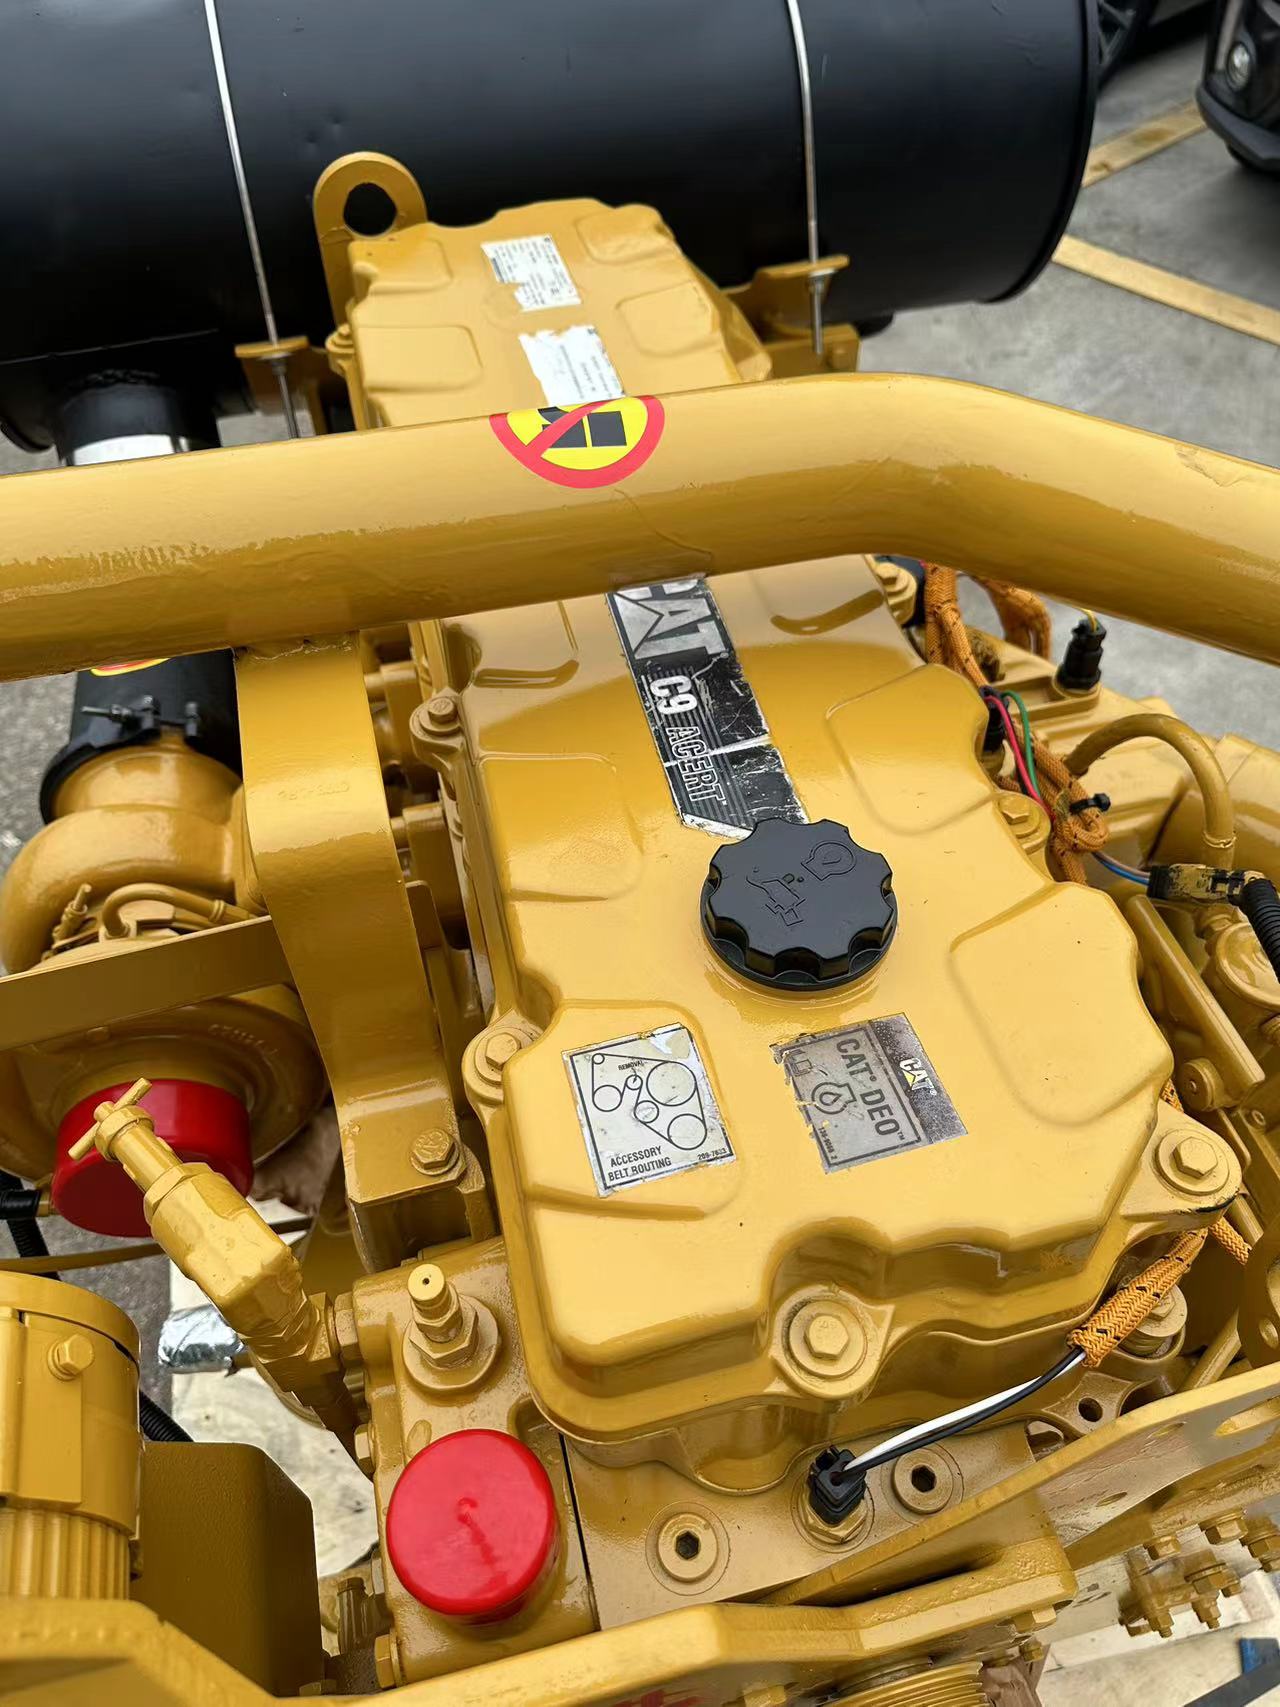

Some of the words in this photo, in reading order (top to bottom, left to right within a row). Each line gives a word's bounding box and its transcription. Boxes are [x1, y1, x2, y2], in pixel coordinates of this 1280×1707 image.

[650, 675, 698, 715] C9
[608, 1168, 629, 1182] BELT
[631, 1156, 672, 1175] ROUTING
[610, 1145, 662, 1168] ACCESSORY
